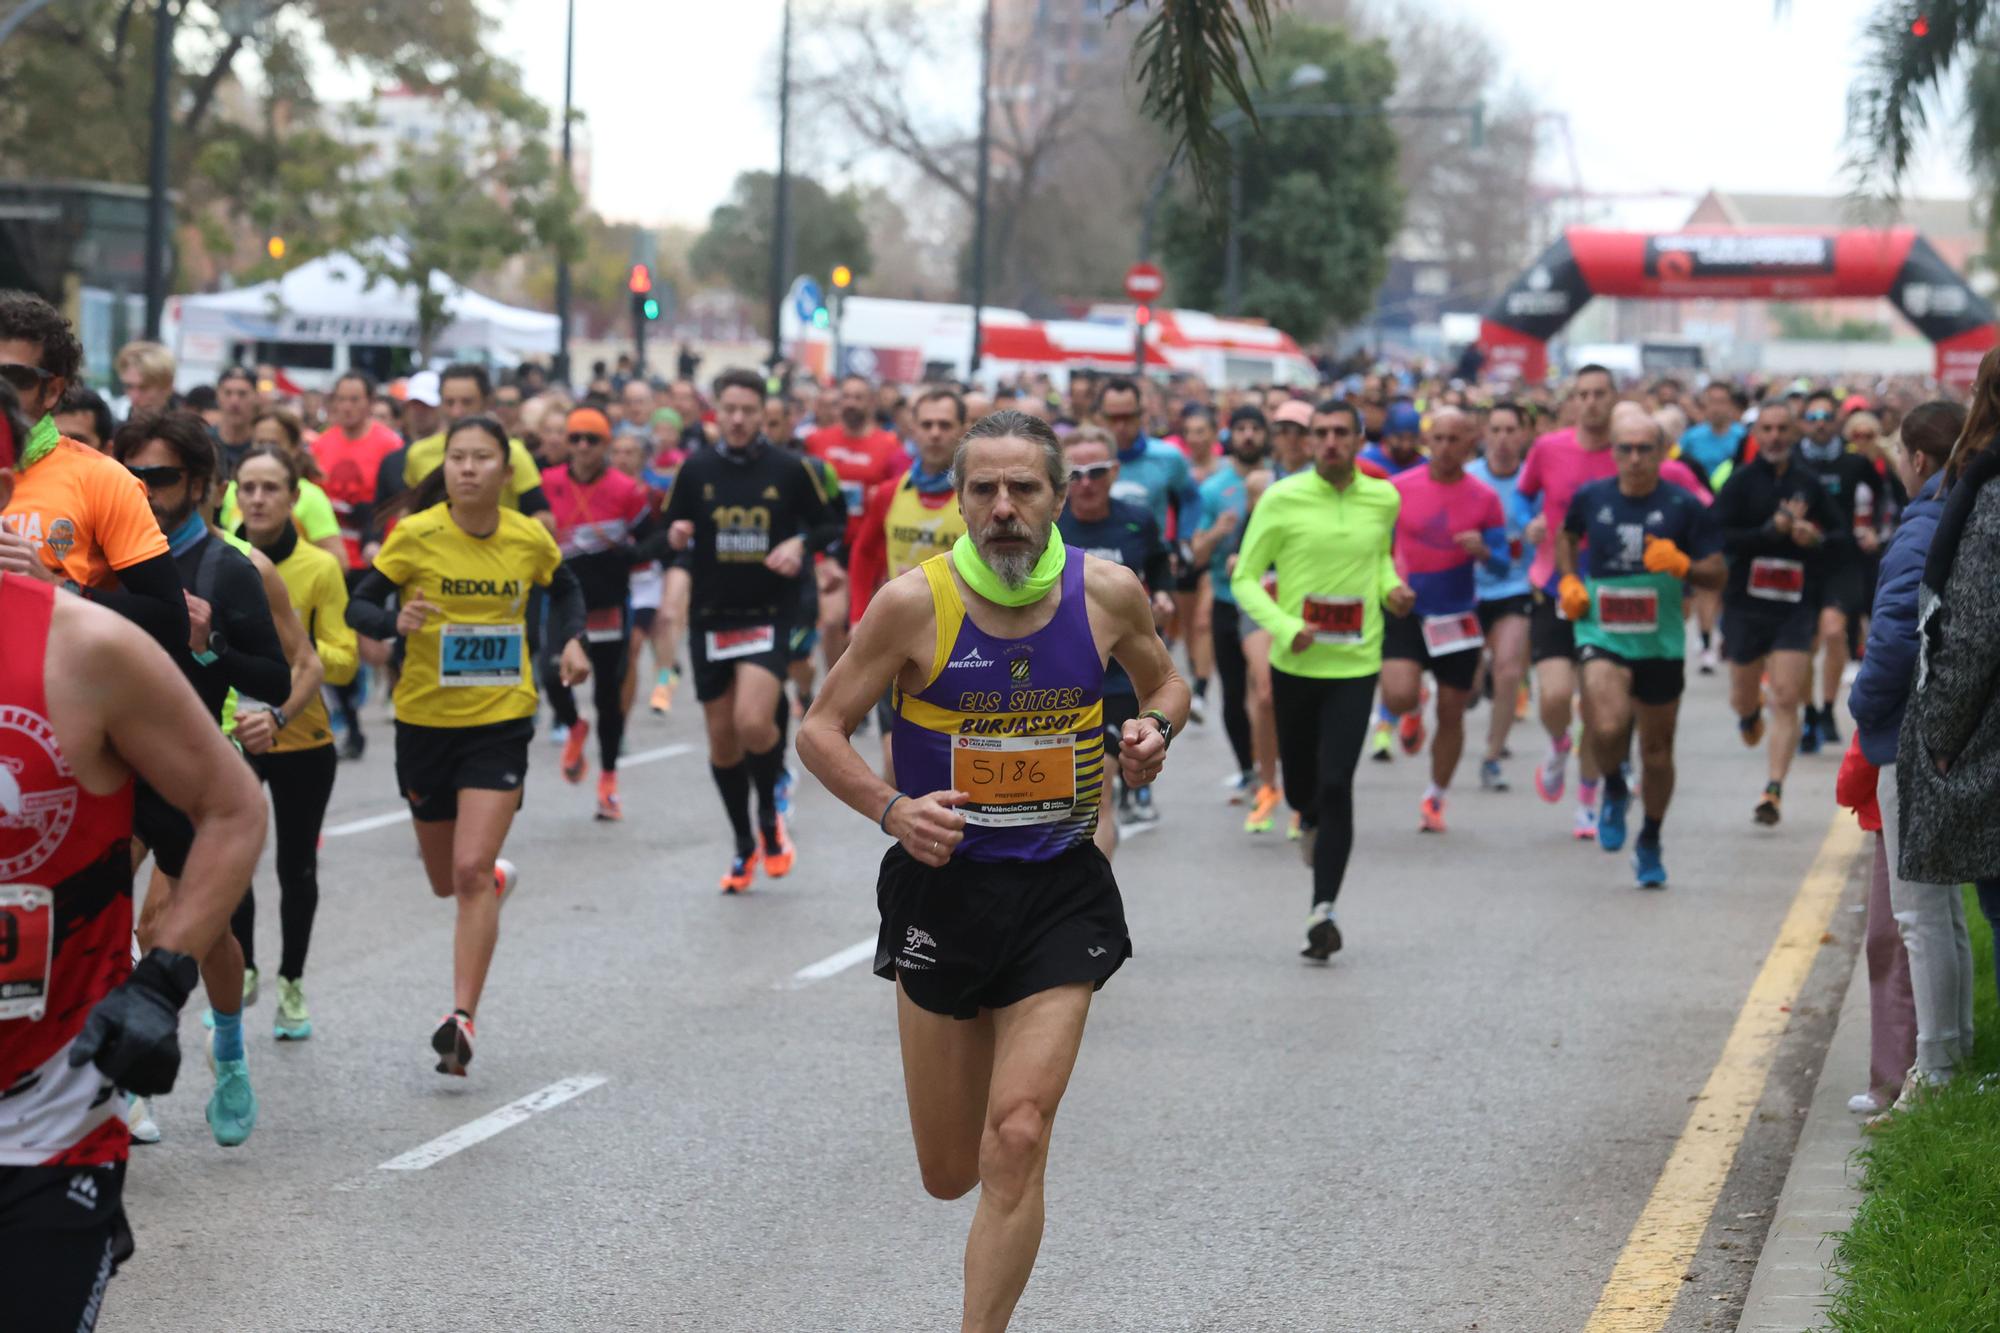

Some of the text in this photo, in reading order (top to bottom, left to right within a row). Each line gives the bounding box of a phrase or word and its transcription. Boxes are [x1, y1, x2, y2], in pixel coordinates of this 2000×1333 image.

[453, 637, 507, 661] 2207
[948, 660, 995, 668] MERCURY
[959, 687, 1082, 712] ELS SITGES
[959, 713, 1080, 734] BURJASSOT
[972, 759, 1045, 784] 5186
[981, 805, 1038, 813] #ValènciaCorre
